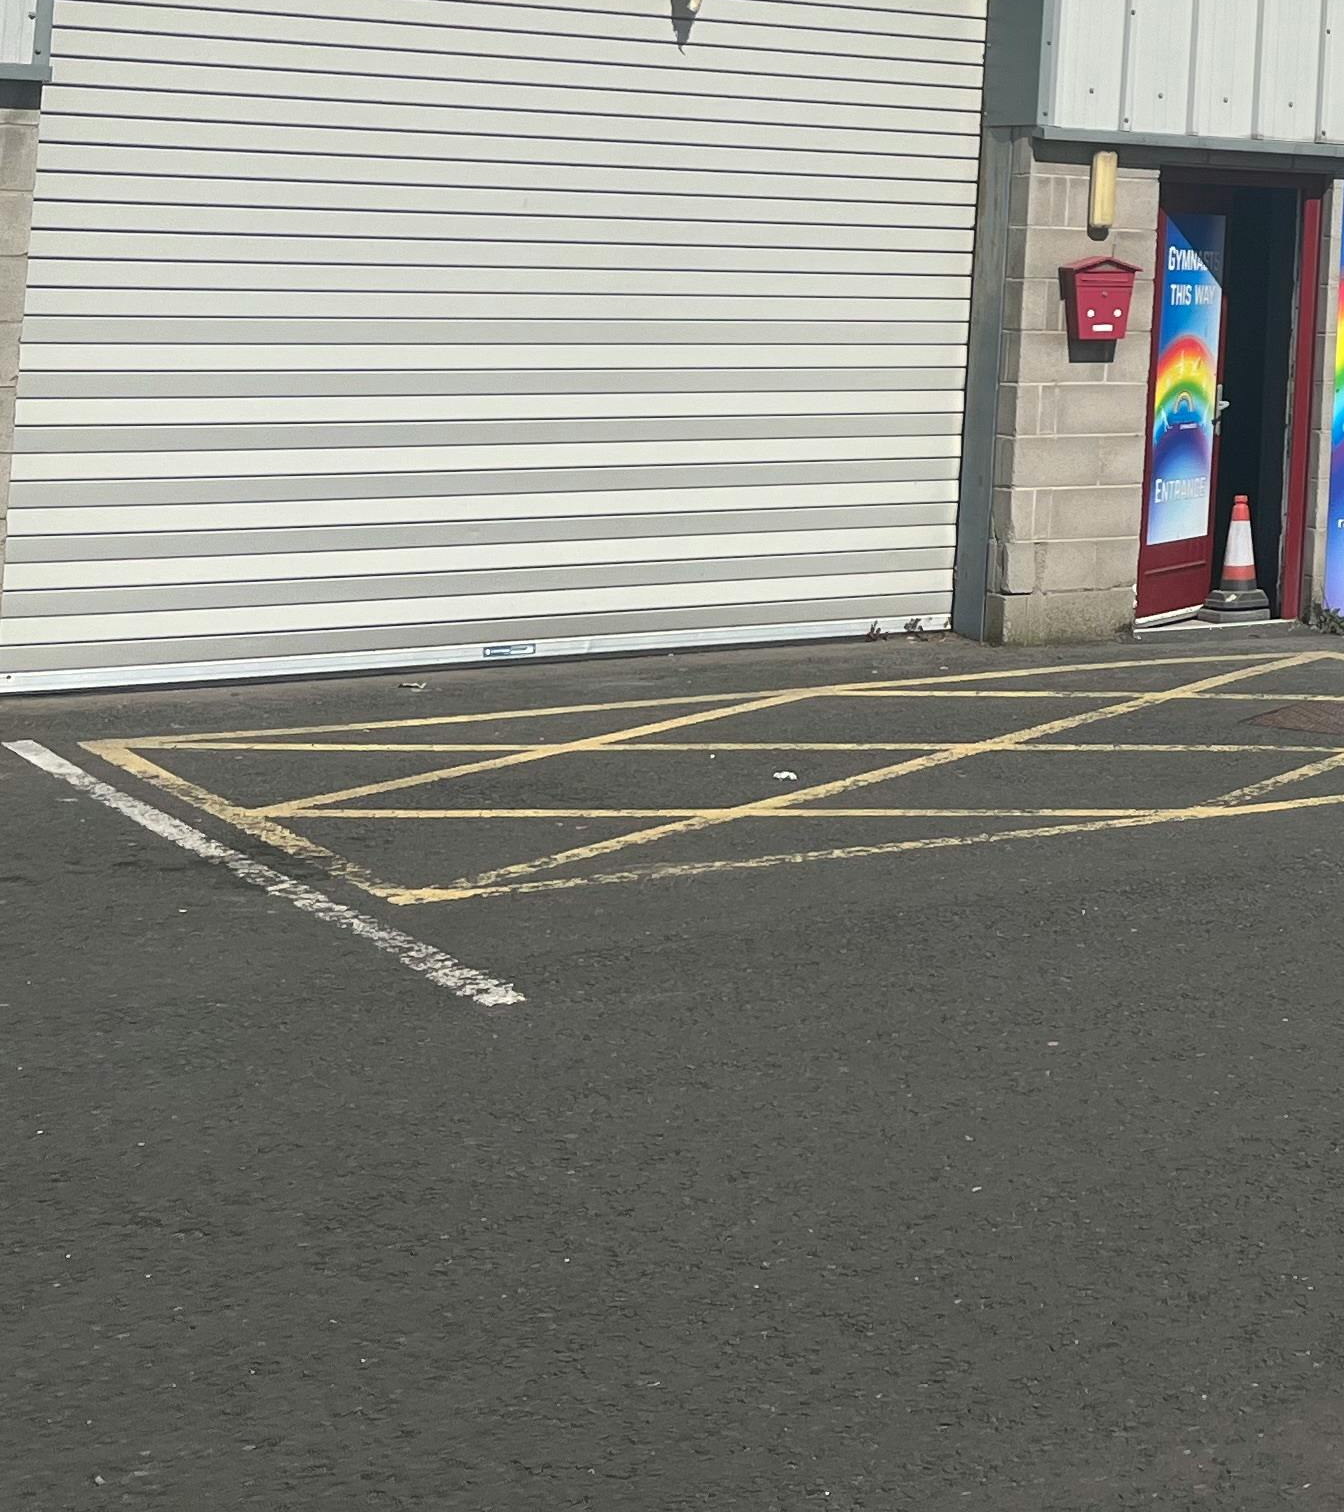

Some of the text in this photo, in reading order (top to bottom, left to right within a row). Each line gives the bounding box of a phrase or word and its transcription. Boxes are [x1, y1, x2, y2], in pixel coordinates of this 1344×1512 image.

[1168, 246, 1220, 272] GYMNASTS
[1170, 284, 1215, 306] THIS WAY
[1155, 477, 1206, 503] ENTRANCE
